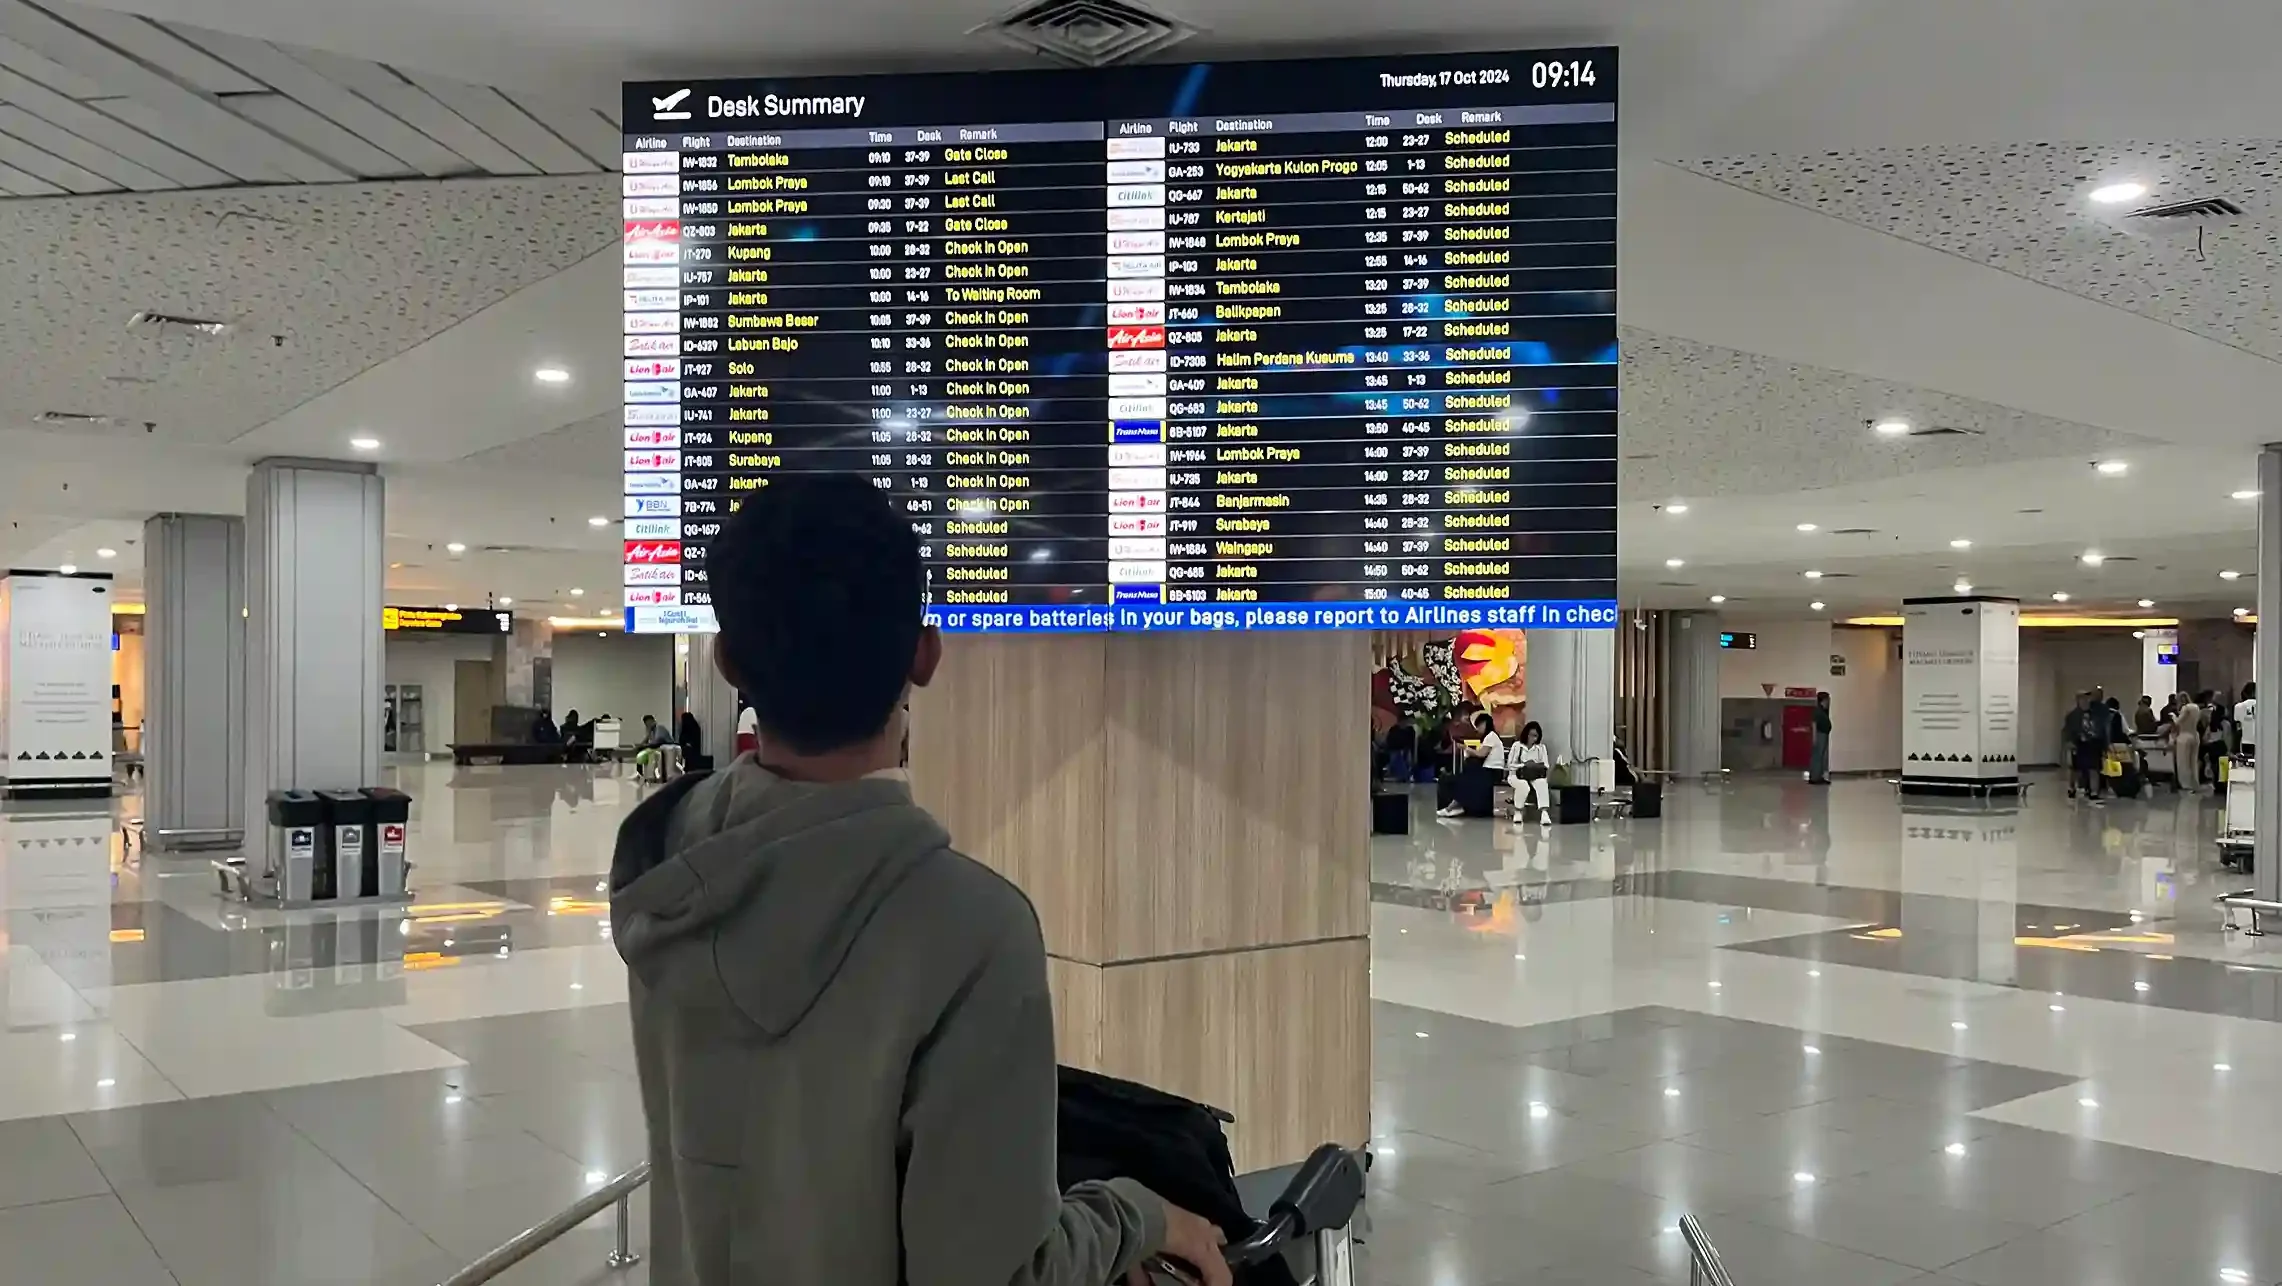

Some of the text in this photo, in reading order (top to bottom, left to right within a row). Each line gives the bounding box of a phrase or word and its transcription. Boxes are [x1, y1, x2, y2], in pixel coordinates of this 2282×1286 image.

[1379, 69, 1510, 88] Thursday, 17 Oct 2024
[1531, 59, 1597, 89] 09:14
[707, 93, 866, 118] Desk Summary
[1119, 110, 1502, 135] Airline Flight Destination Time Desk Remark
[635, 127, 998, 150] Airline Flight Destination Time Desk Remark
[1215, 138, 1258, 153] Jakarta
[1444, 129, 1511, 145] Scheduled
[727, 152, 789, 168] Tambolaka
[944, 148, 972, 162] Gate
[974, 147, 1008, 161] Close
[1215, 161, 1282, 179] Yogyakarta
[1284, 160, 1320, 175] Kulon
[1321, 159, 1358, 175] Progo
[727, 170, 996, 191] Lombok Praya Last Call
[1215, 186, 1258, 201] Jakarta
[1444, 178, 1510, 193] Scheduled
[727, 193, 996, 215] Lombok Praya Last Call
[727, 216, 1008, 237] Jakarta Gate Close
[1215, 208, 1266, 225] Kertajati
[1215, 225, 1510, 248] Lombok Praya Scheduled
[727, 245, 771, 262] Kupang
[945, 240, 983, 255] Check
[997, 239, 1029, 256] Open
[727, 268, 768, 283] Jakarta
[945, 263, 983, 279] Check
[997, 263, 1029, 280] Open
[1215, 257, 1257, 272] Jakarta
[1215, 279, 1281, 295] Tambolaka
[1444, 273, 1510, 289] Scheduled
[727, 291, 768, 306] Jakarta
[945, 287, 961, 302] To
[961, 287, 1005, 303] Waiting
[1006, 286, 1041, 301] Room
[727, 314, 784, 329] Sumbawa
[785, 313, 819, 328] Besar
[945, 310, 984, 325] Check
[998, 310, 1029, 326] Open
[1215, 304, 1282, 320] Balikpapan
[1215, 328, 1258, 343] Jakarta
[1443, 321, 1510, 337] Scheduled
[727, 337, 770, 352] Labuan
[771, 336, 799, 353] Bajo
[945, 333, 984, 348] Check
[998, 333, 1029, 349] Open
[728, 361, 755, 375] Solo
[1216, 350, 1356, 368] Halim Perdana Kusuma
[1216, 376, 1259, 390] Jakarta
[1445, 369, 1511, 385] Scheduled
[728, 384, 769, 398] Jakarta
[728, 407, 769, 421] Jakarta
[1216, 399, 1259, 414] Jakarta
[1216, 423, 1259, 438] Jakarta
[1444, 417, 1511, 433] Scheduled
[728, 430, 773, 446] Kupang
[630, 455, 650, 465] Lion
[728, 453, 781, 469] Surabaya
[1216, 446, 1265, 462] Lombok
[1266, 446, 1301, 462] Praya
[1215, 466, 1510, 485] Jakarta Scheduled
[1216, 493, 1290, 510] Banjarmasin
[1215, 517, 1270, 533] Surabaya
[1444, 513, 1510, 528] Scheduled
[946, 543, 1008, 558] Scheduled
[1215, 540, 1273, 557] Waingapu
[1215, 561, 1510, 578] Jakarta Scheduled
[946, 589, 1008, 604] Scheduled
[1215, 587, 1258, 602] Jakarta
[947, 612, 967, 627] or
[971, 612, 1023, 631] spare
[1029, 608, 1115, 627] batteries
[1142, 609, 1185, 629] your
[1189, 607, 1240, 629] bags,
[1245, 606, 1309, 629] please
[1314, 606, 1374, 629] report
[1379, 606, 1400, 624] to
[1404, 605, 1482, 625] Airlines
[1487, 604, 1537, 624] staff
[1566, 603, 1617, 623] chec
